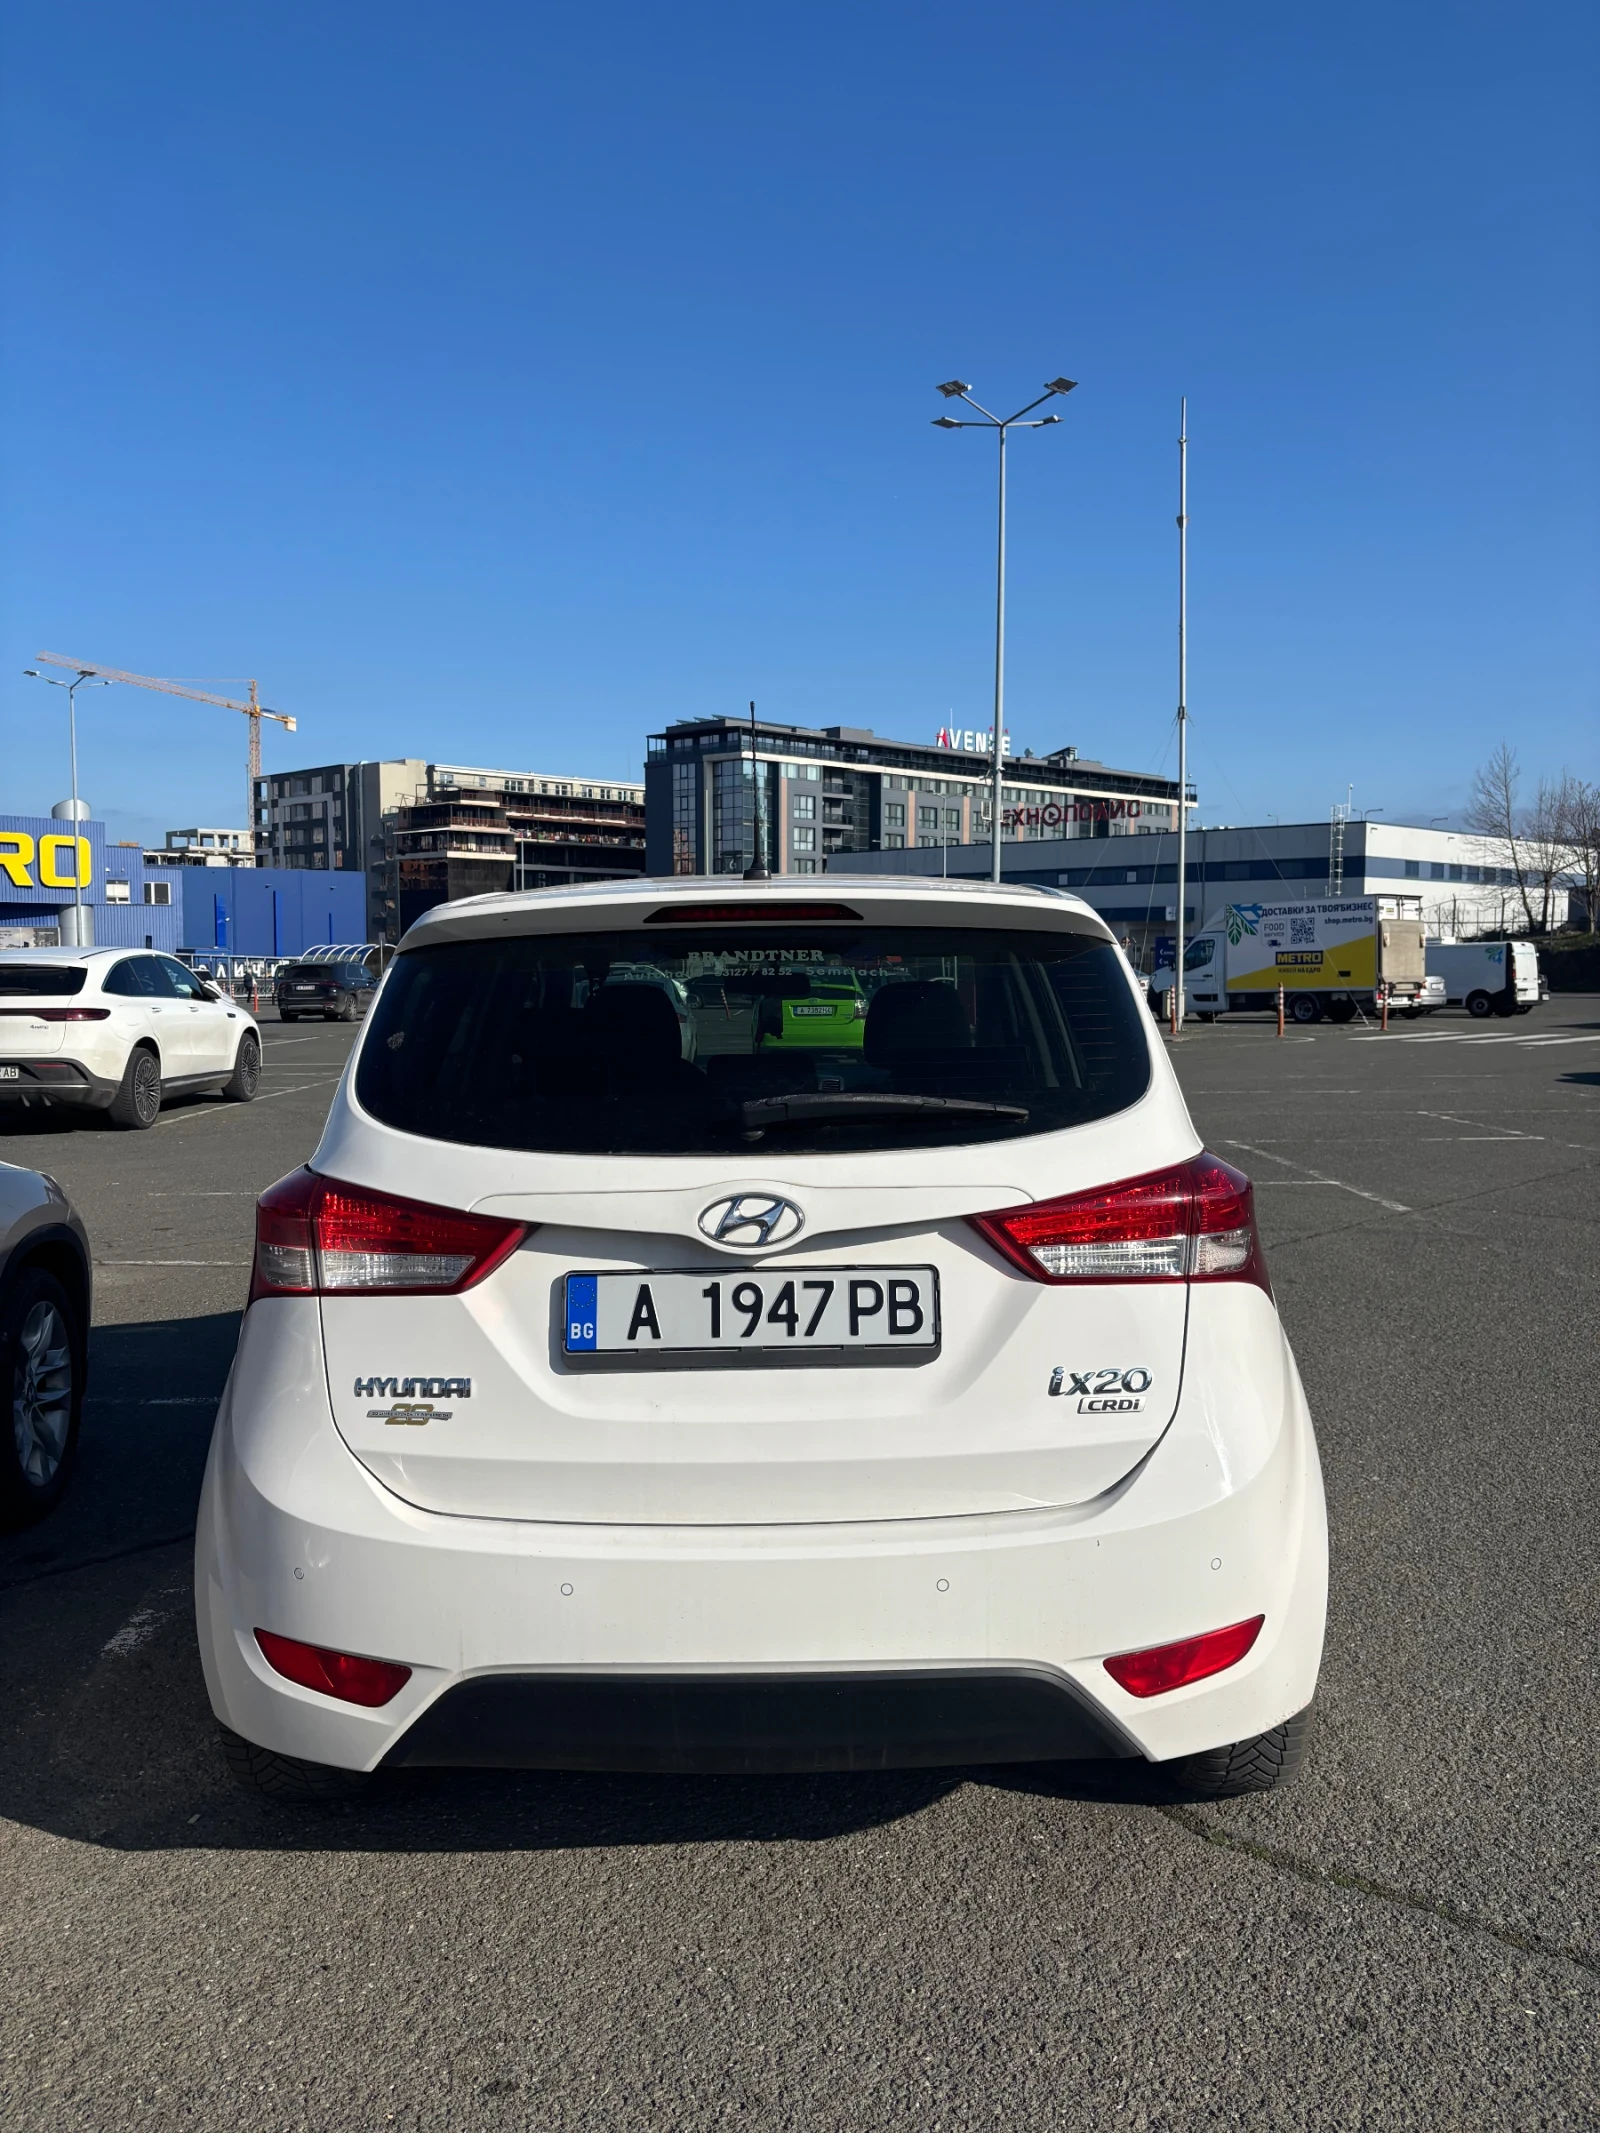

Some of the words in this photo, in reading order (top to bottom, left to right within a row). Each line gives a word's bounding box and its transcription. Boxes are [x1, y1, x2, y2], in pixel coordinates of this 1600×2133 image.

[1000, 799, 1142, 827] ЕХНОПОЛИС
[0, 832, 91, 888] RO
[1261, 906, 1304, 917] ДОСТАВКИ
[1305, 905, 1316, 914] ЗА
[1340, 902, 1373, 912] БИЗНЕС
[1263, 923, 1285, 932] FOOD
[1324, 915, 1373, 925] shop.metro.bg
[688, 950, 825, 962] BRANDTNER
[1277, 952, 1322, 963] METRO
[761, 968, 775, 976] 82
[778, 967, 792, 976] 52
[806, 966, 888, 977] Semriach
[627, 1283, 662, 1341] A
[702, 1280, 835, 1339] 1947
[849, 1279, 924, 1337] PB
[570, 1323, 594, 1340] BG
[354, 1376, 471, 1398] HYUNDAI
[1047, 1366, 1153, 1396] ix20
[1088, 1398, 1140, 1411] CRDi
